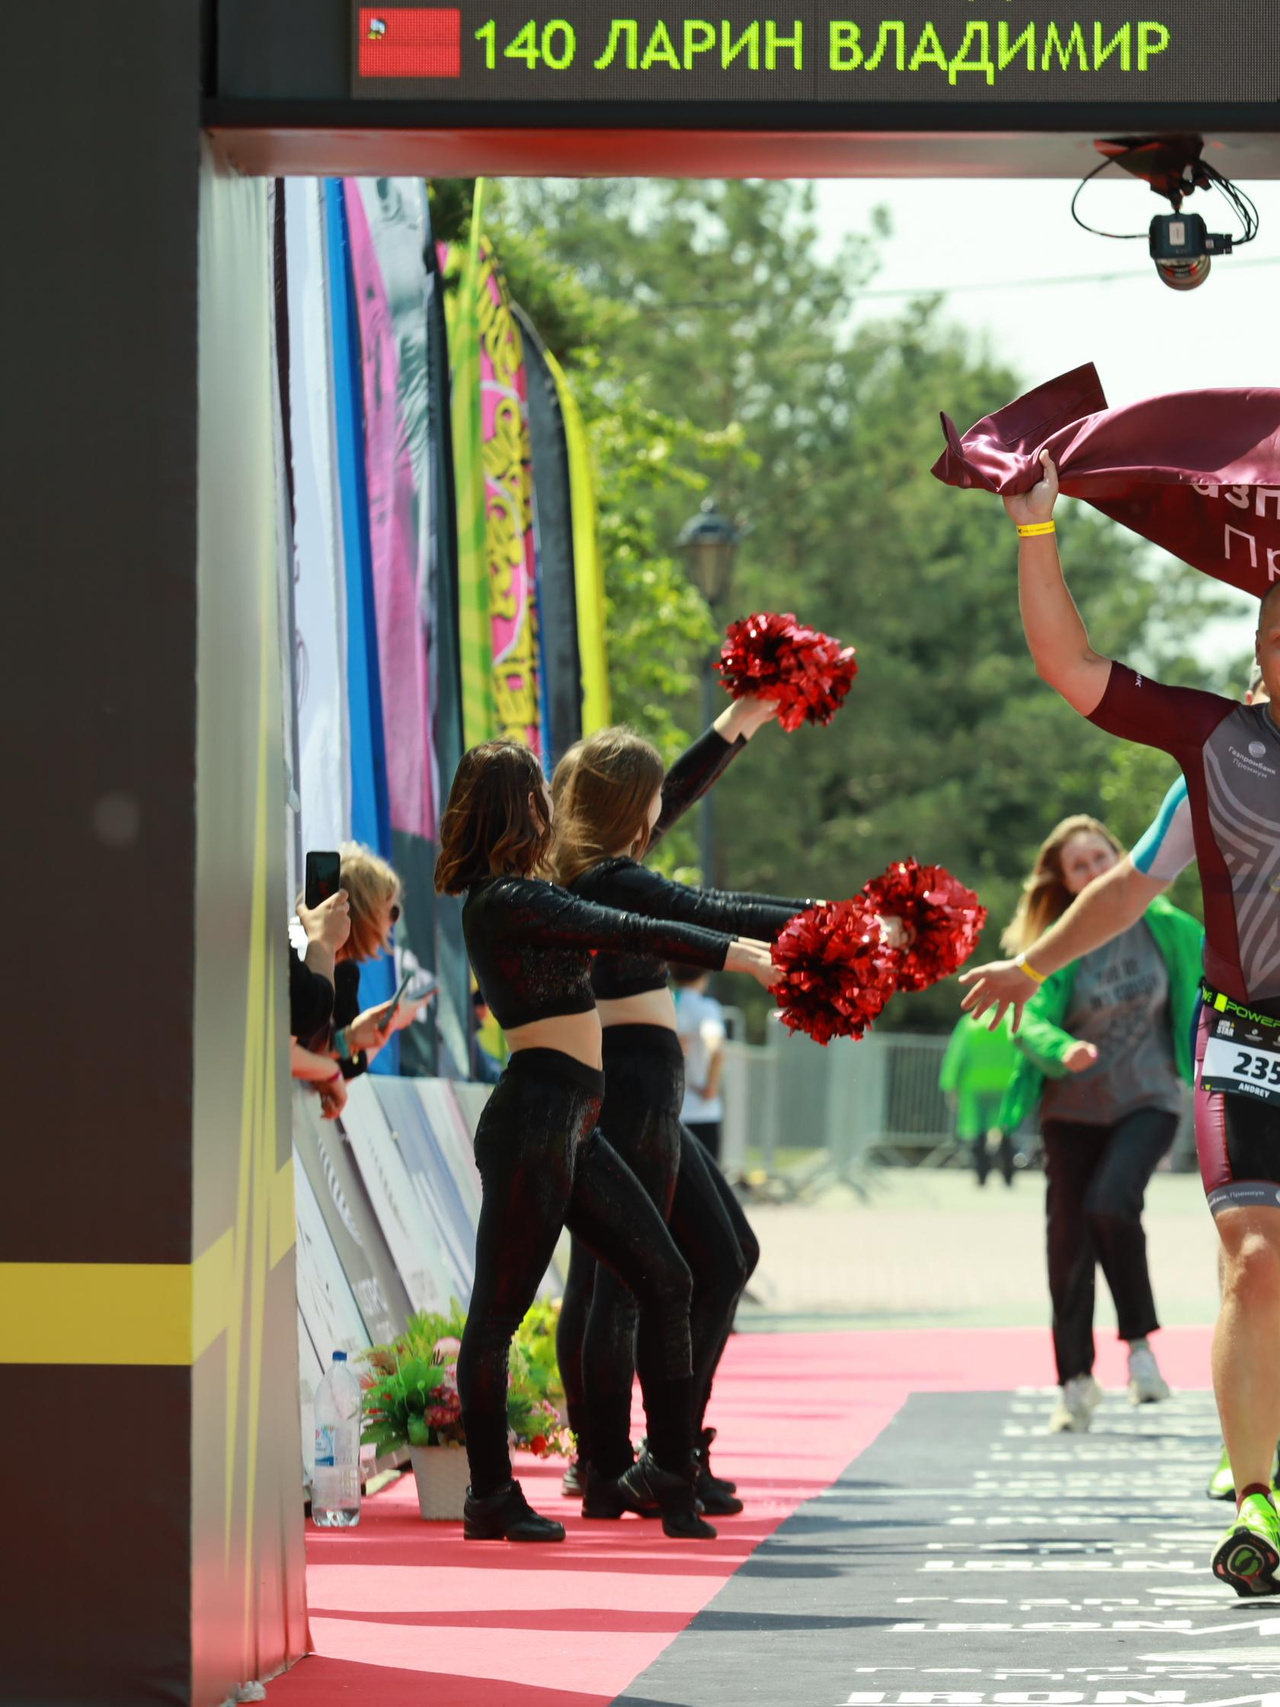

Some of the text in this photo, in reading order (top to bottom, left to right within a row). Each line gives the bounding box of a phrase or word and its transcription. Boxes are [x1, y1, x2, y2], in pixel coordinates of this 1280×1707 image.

[473, 18, 1171, 85] 140 ЛАРИН ВЛАДИМИР
[1238, 1082, 1271, 1099] ANDREY
[892, 1619, 1193, 1631] IRON
[846, 1690, 1187, 1704] IRON
